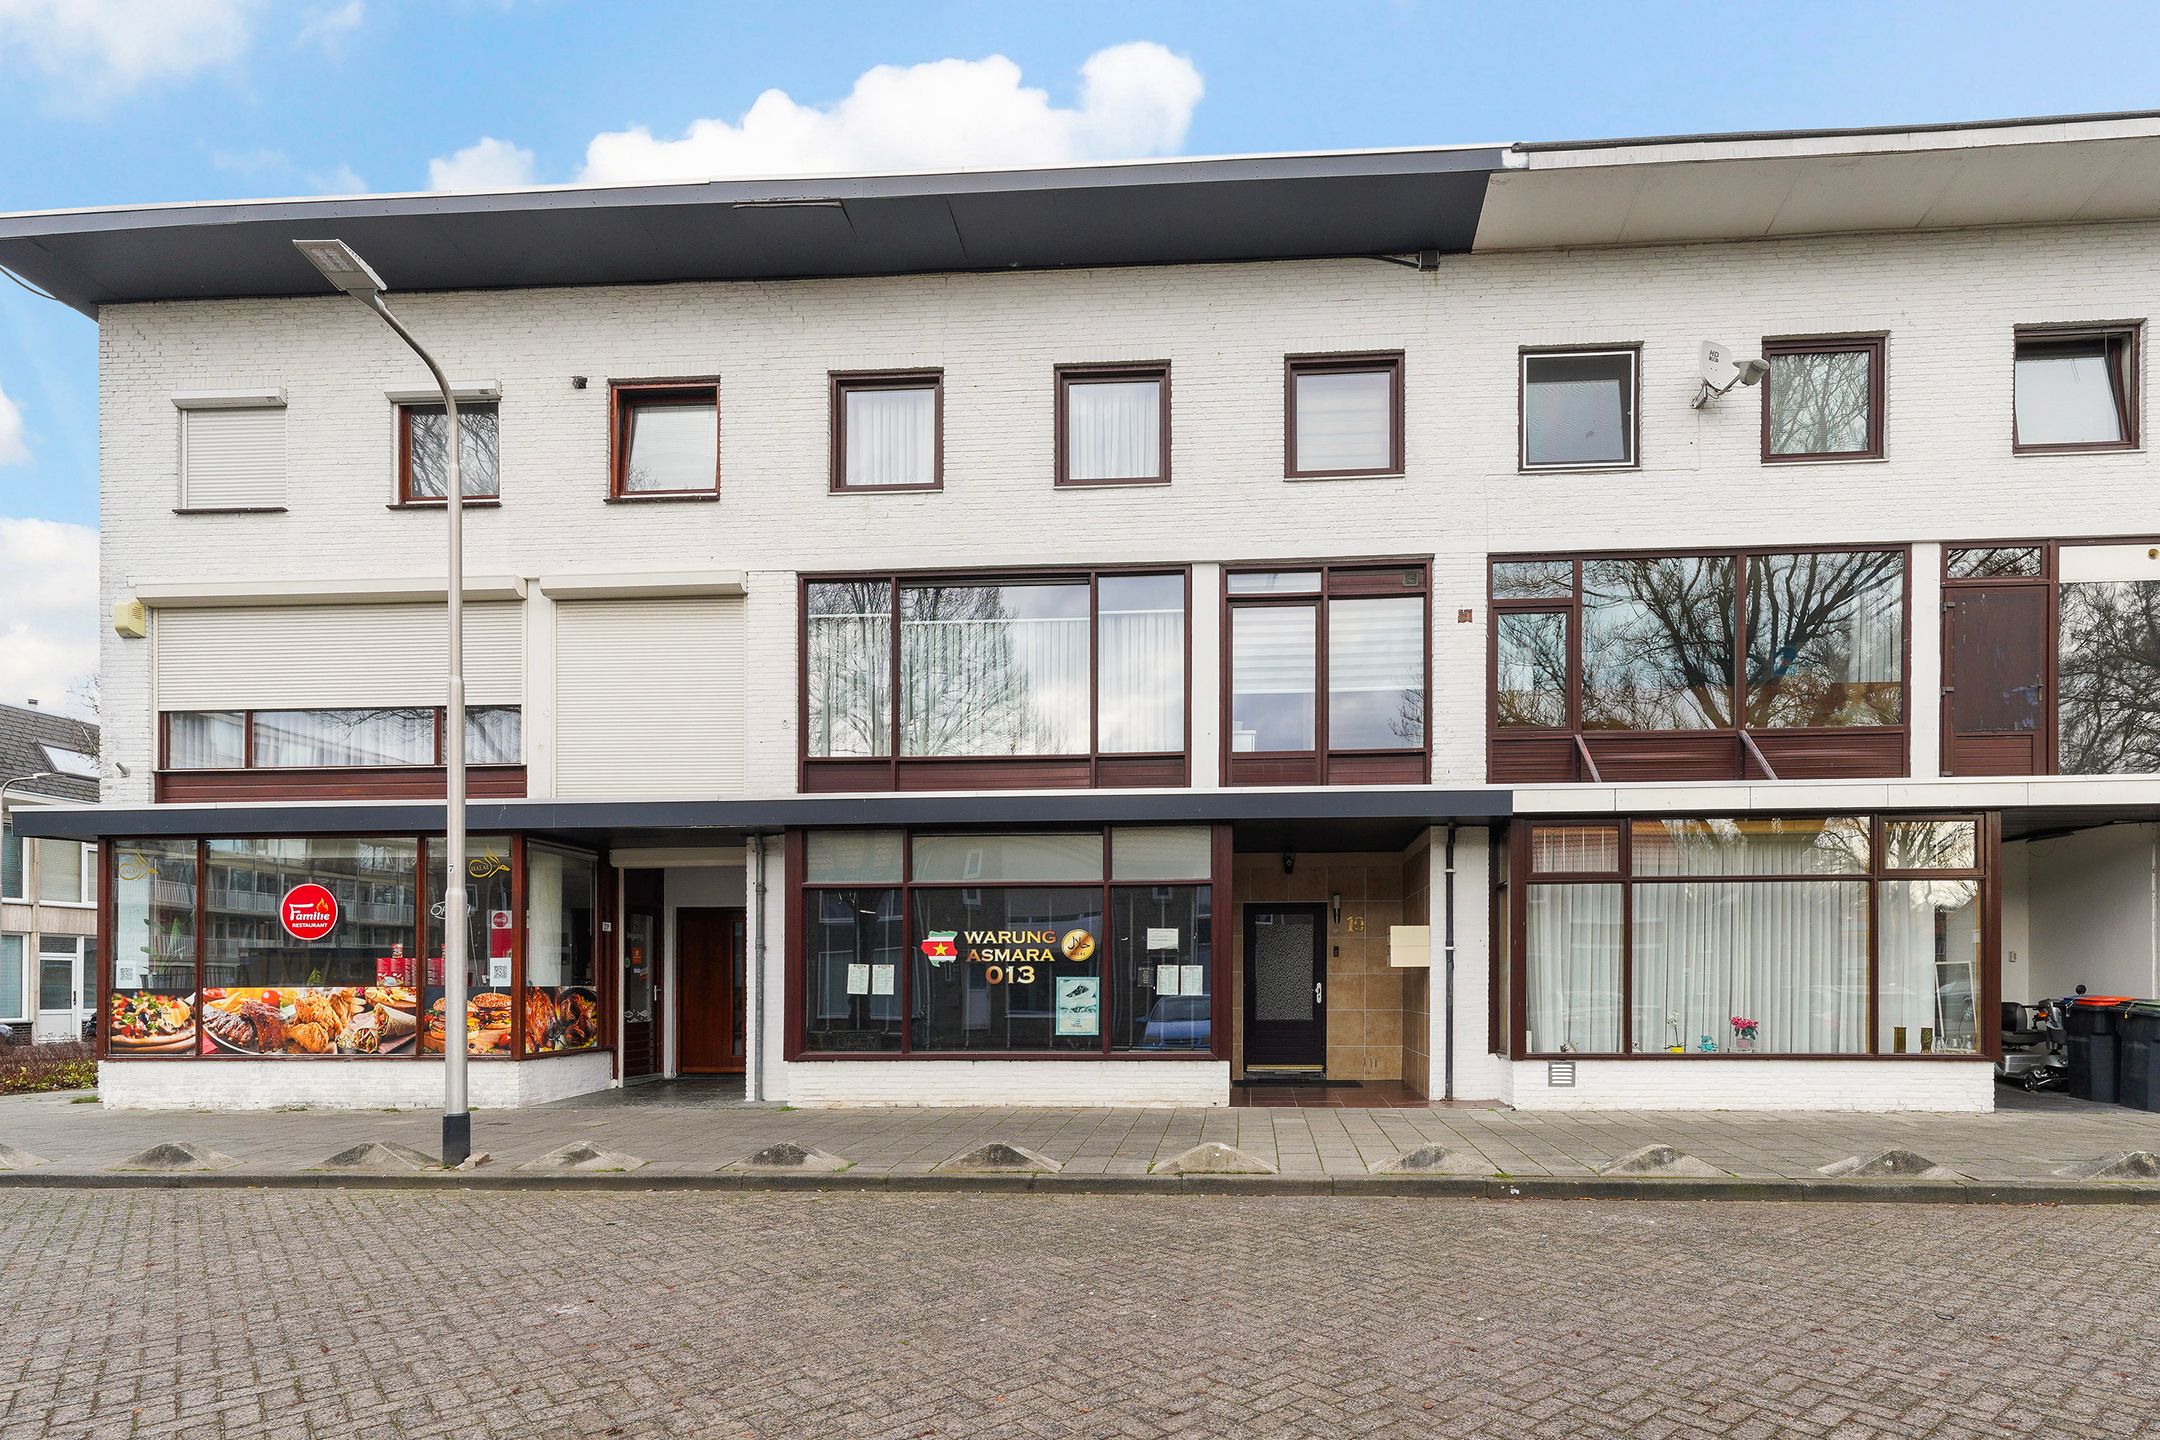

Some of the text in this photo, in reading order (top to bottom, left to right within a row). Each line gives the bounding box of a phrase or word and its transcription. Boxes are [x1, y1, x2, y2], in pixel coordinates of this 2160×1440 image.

[1709, 350, 1720, 358] HD
[449, 864, 454, 873] 7
[289, 903, 330, 921] Familie
[963, 930, 1056, 944] WARUNG
[966, 948, 1055, 962] ASMARA
[985, 965, 1036, 985] 013
